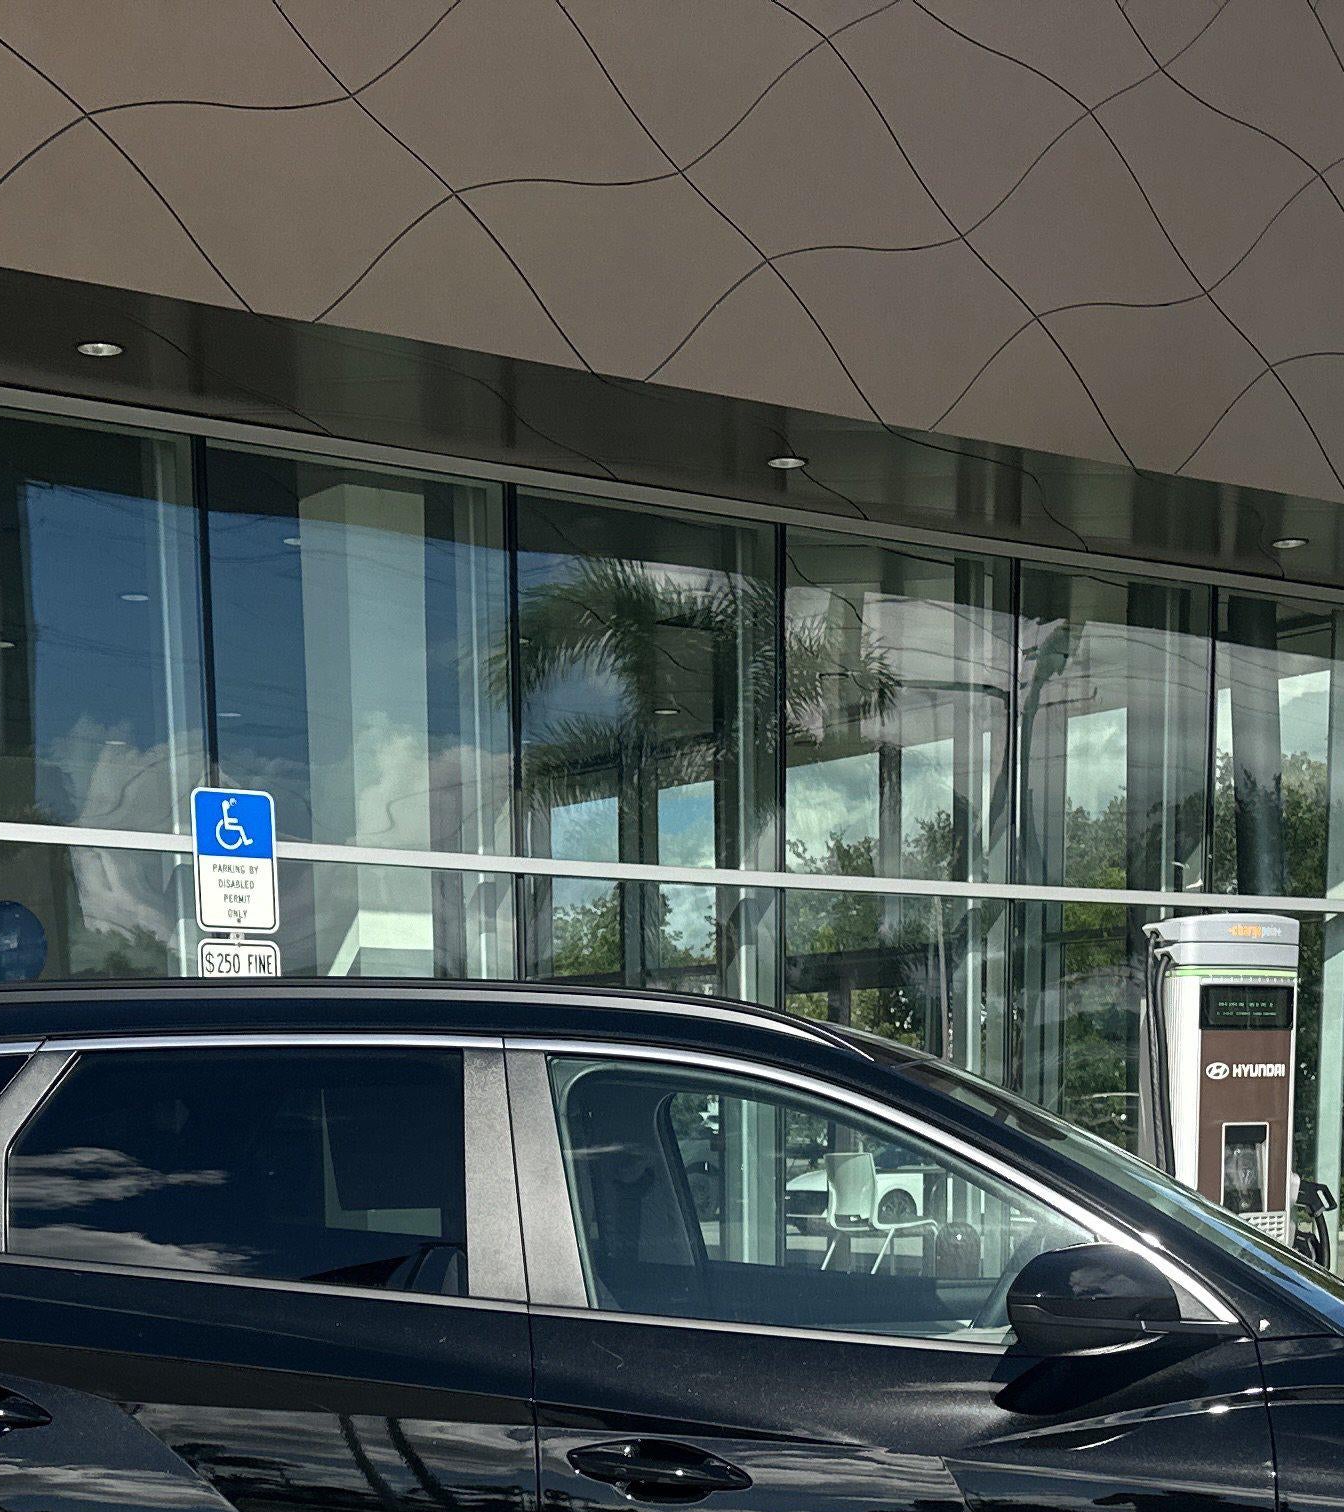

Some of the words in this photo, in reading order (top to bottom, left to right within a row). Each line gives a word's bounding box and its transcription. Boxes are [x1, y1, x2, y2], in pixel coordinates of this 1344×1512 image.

[212, 864, 246, 874] PARKING
[249, 865, 259, 875] BY
[218, 878, 255, 890] DISABLED
[223, 893, 251, 904] PERMIT
[227, 908, 248, 919] ONLY
[205, 951, 241, 974] $250
[247, 953, 273, 975] FINE
[1232, 1063, 1286, 1078] HYUNDAI
